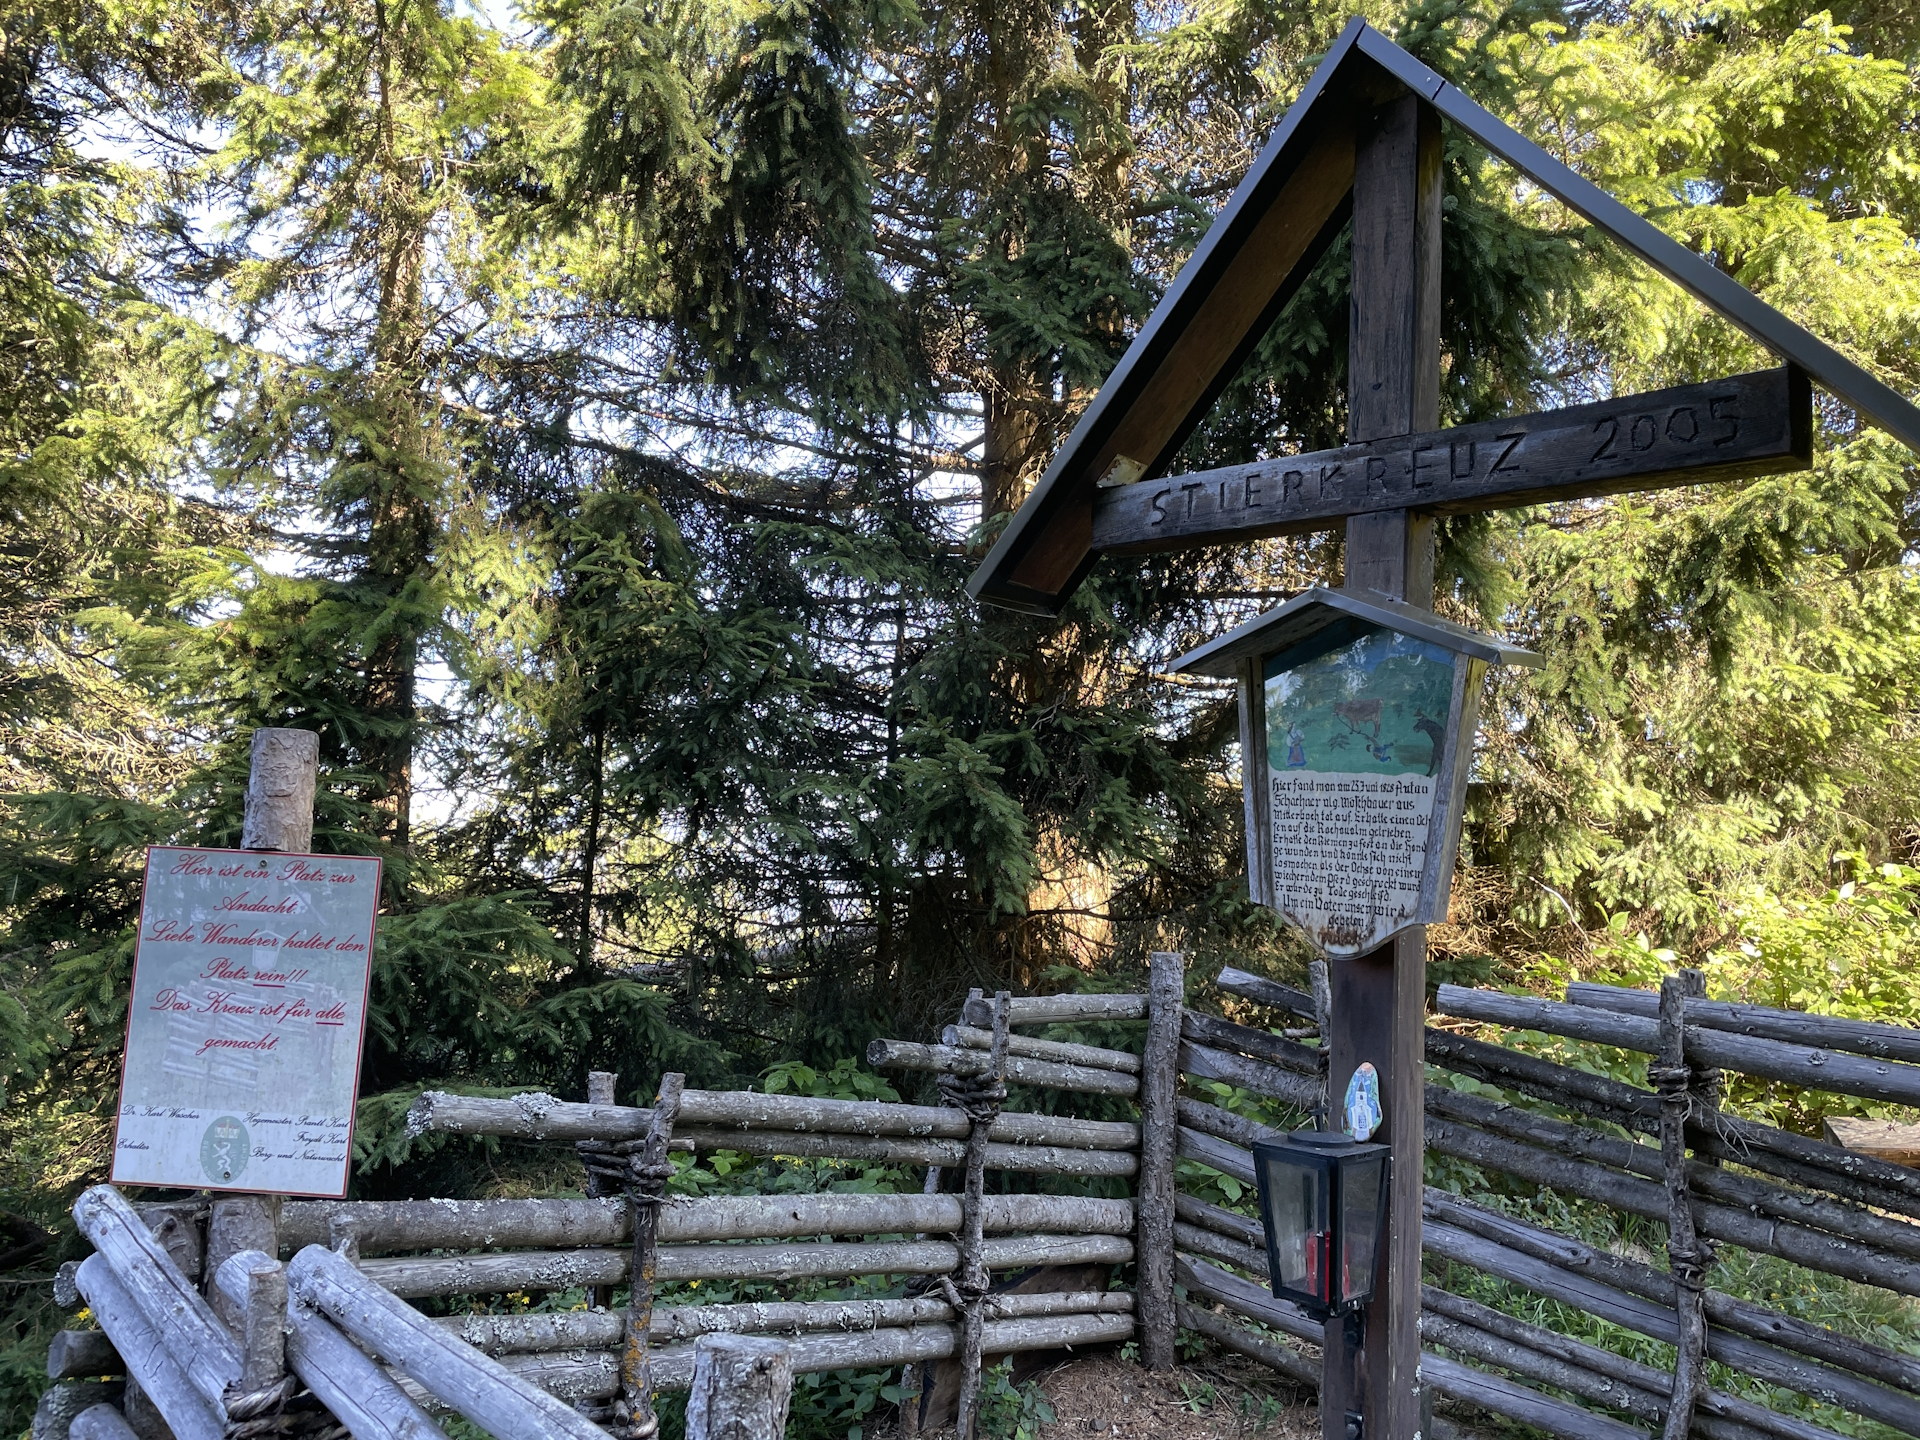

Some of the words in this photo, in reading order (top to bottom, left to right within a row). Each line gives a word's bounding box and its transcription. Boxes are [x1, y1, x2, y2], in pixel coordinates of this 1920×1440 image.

[1149, 431, 1528, 526] STIERKREUZ
[1590, 395, 1739, 463] 2005
[1272, 777, 1291, 794] Hier
[1293, 778, 1314, 794] fand
[1316, 782, 1335, 792] man
[1337, 782, 1350, 792] am
[1396, 801, 1415, 810] aus
[1389, 814, 1414, 825] einen
[1304, 822, 1315, 833] die
[1304, 835, 1317, 845] den
[1390, 839, 1402, 850] die
[1321, 849, 1338, 859] und
[1389, 852, 1412, 866] nicht
[171, 854, 213, 876] Hier
[219, 864, 243, 878] ist
[243, 868, 269, 878] ein
[277, 860, 324, 882] Platz
[329, 873, 357, 884] zur
[1320, 861, 1332, 871] als
[1335, 859, 1349, 872] der
[1275, 882, 1285, 891] Er
[1327, 886, 1347, 897] Tode
[213, 891, 297, 914] Andacht.
[1282, 894, 1299, 908] Um
[1300, 897, 1314, 909] ein
[145, 920, 195, 943] Liebe
[201, 923, 279, 947] Wanderer
[282, 932, 336, 951] haltet
[335, 934, 366, 952] den
[200, 957, 249, 980] Platz
[253, 969, 308, 983] rein!!!
[150, 988, 192, 1011] Das
[197, 991, 256, 1014] Kreuz
[259, 1001, 284, 1016] ist
[278, 999, 312, 1024] für
[315, 1002, 347, 1020] alle
[195, 1033, 280, 1056] gemacht.
[121, 1104, 136, 1116] Dr.
[140, 1106, 166, 1117] Karl
[243, 1112, 292, 1127] Hegemeister
[325, 1117, 350, 1128] Karl
[324, 1133, 349, 1144] Karl
[277, 1151, 297, 1159] und
[295, 1150, 346, 1162] Naturwacht
